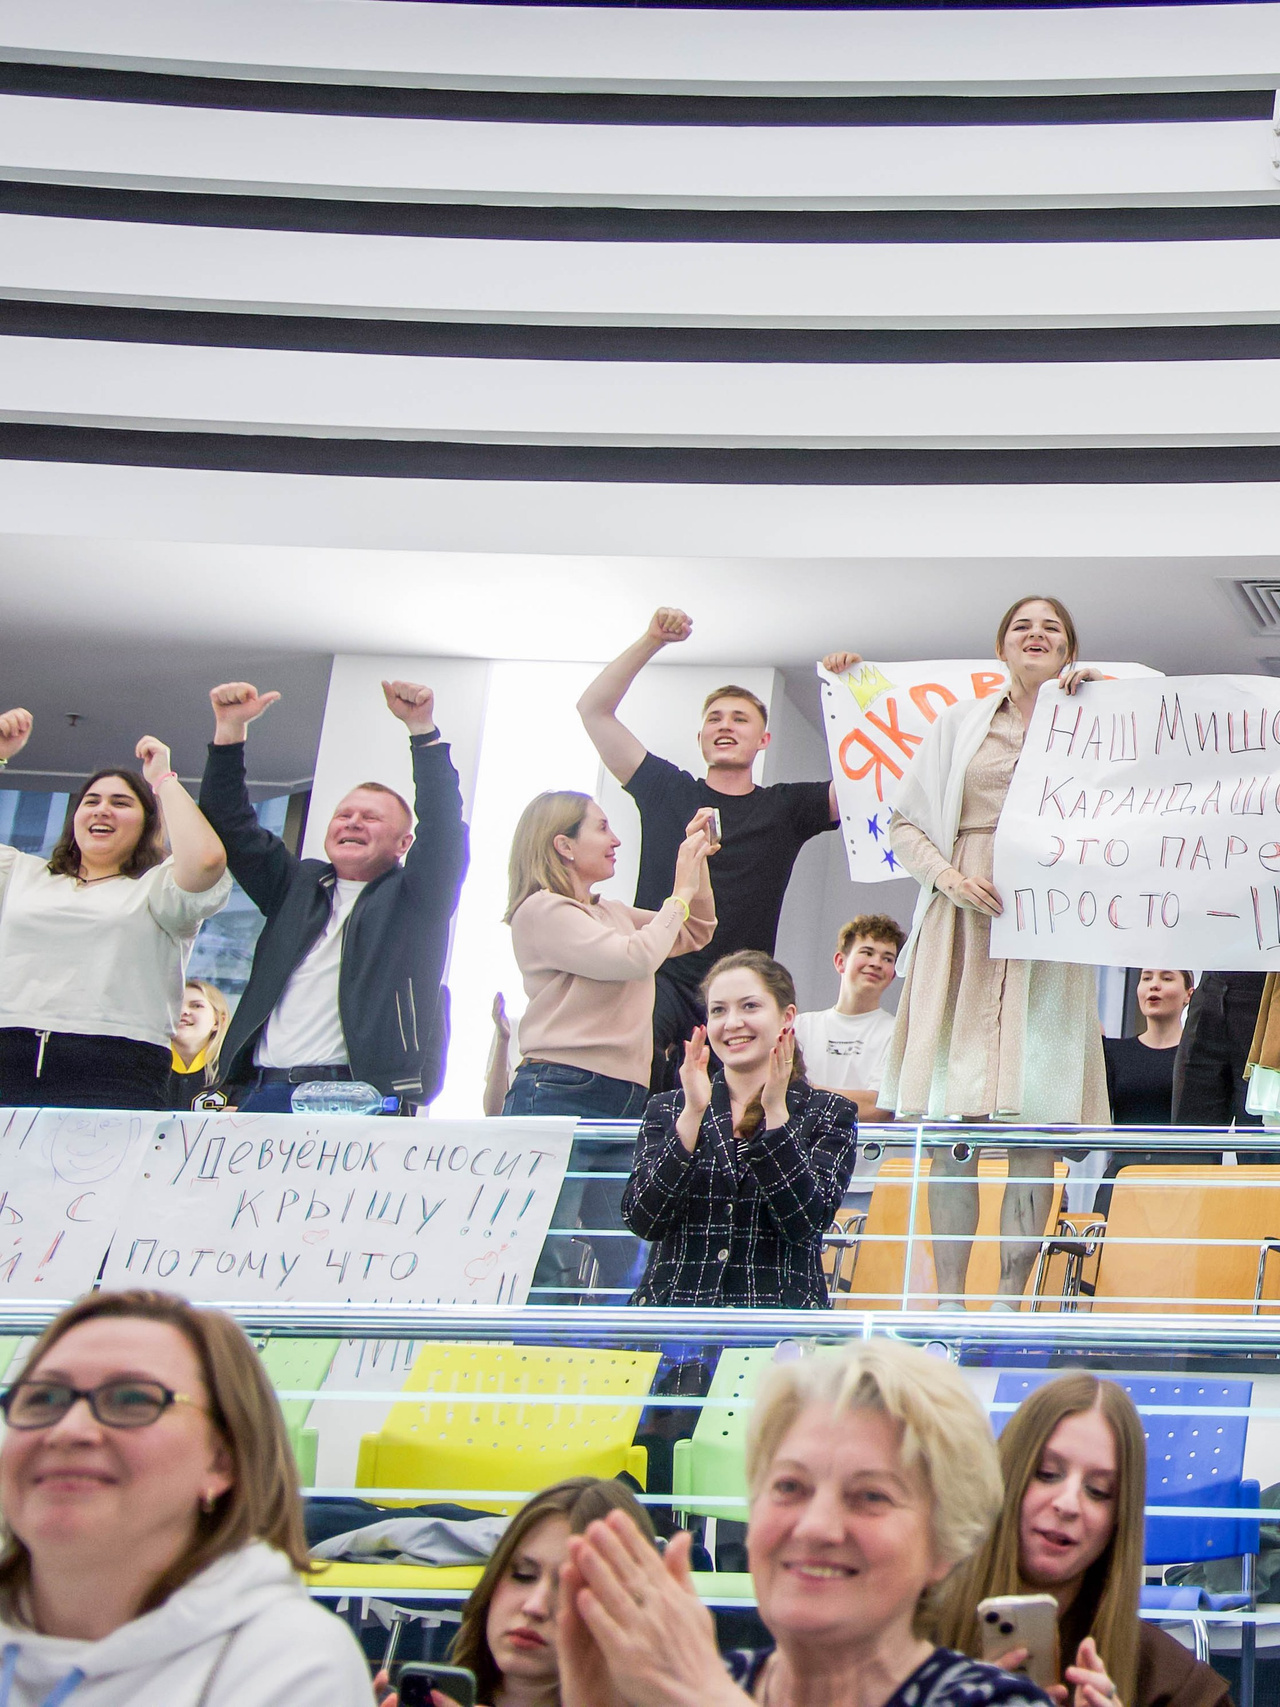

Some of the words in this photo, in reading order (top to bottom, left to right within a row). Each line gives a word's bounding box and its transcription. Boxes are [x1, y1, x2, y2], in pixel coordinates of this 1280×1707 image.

[1045, 704, 1137, 762] НАШ
[1037, 835, 1130, 868] ЭТО
[1014, 887, 1181, 935] ПРОСТО
